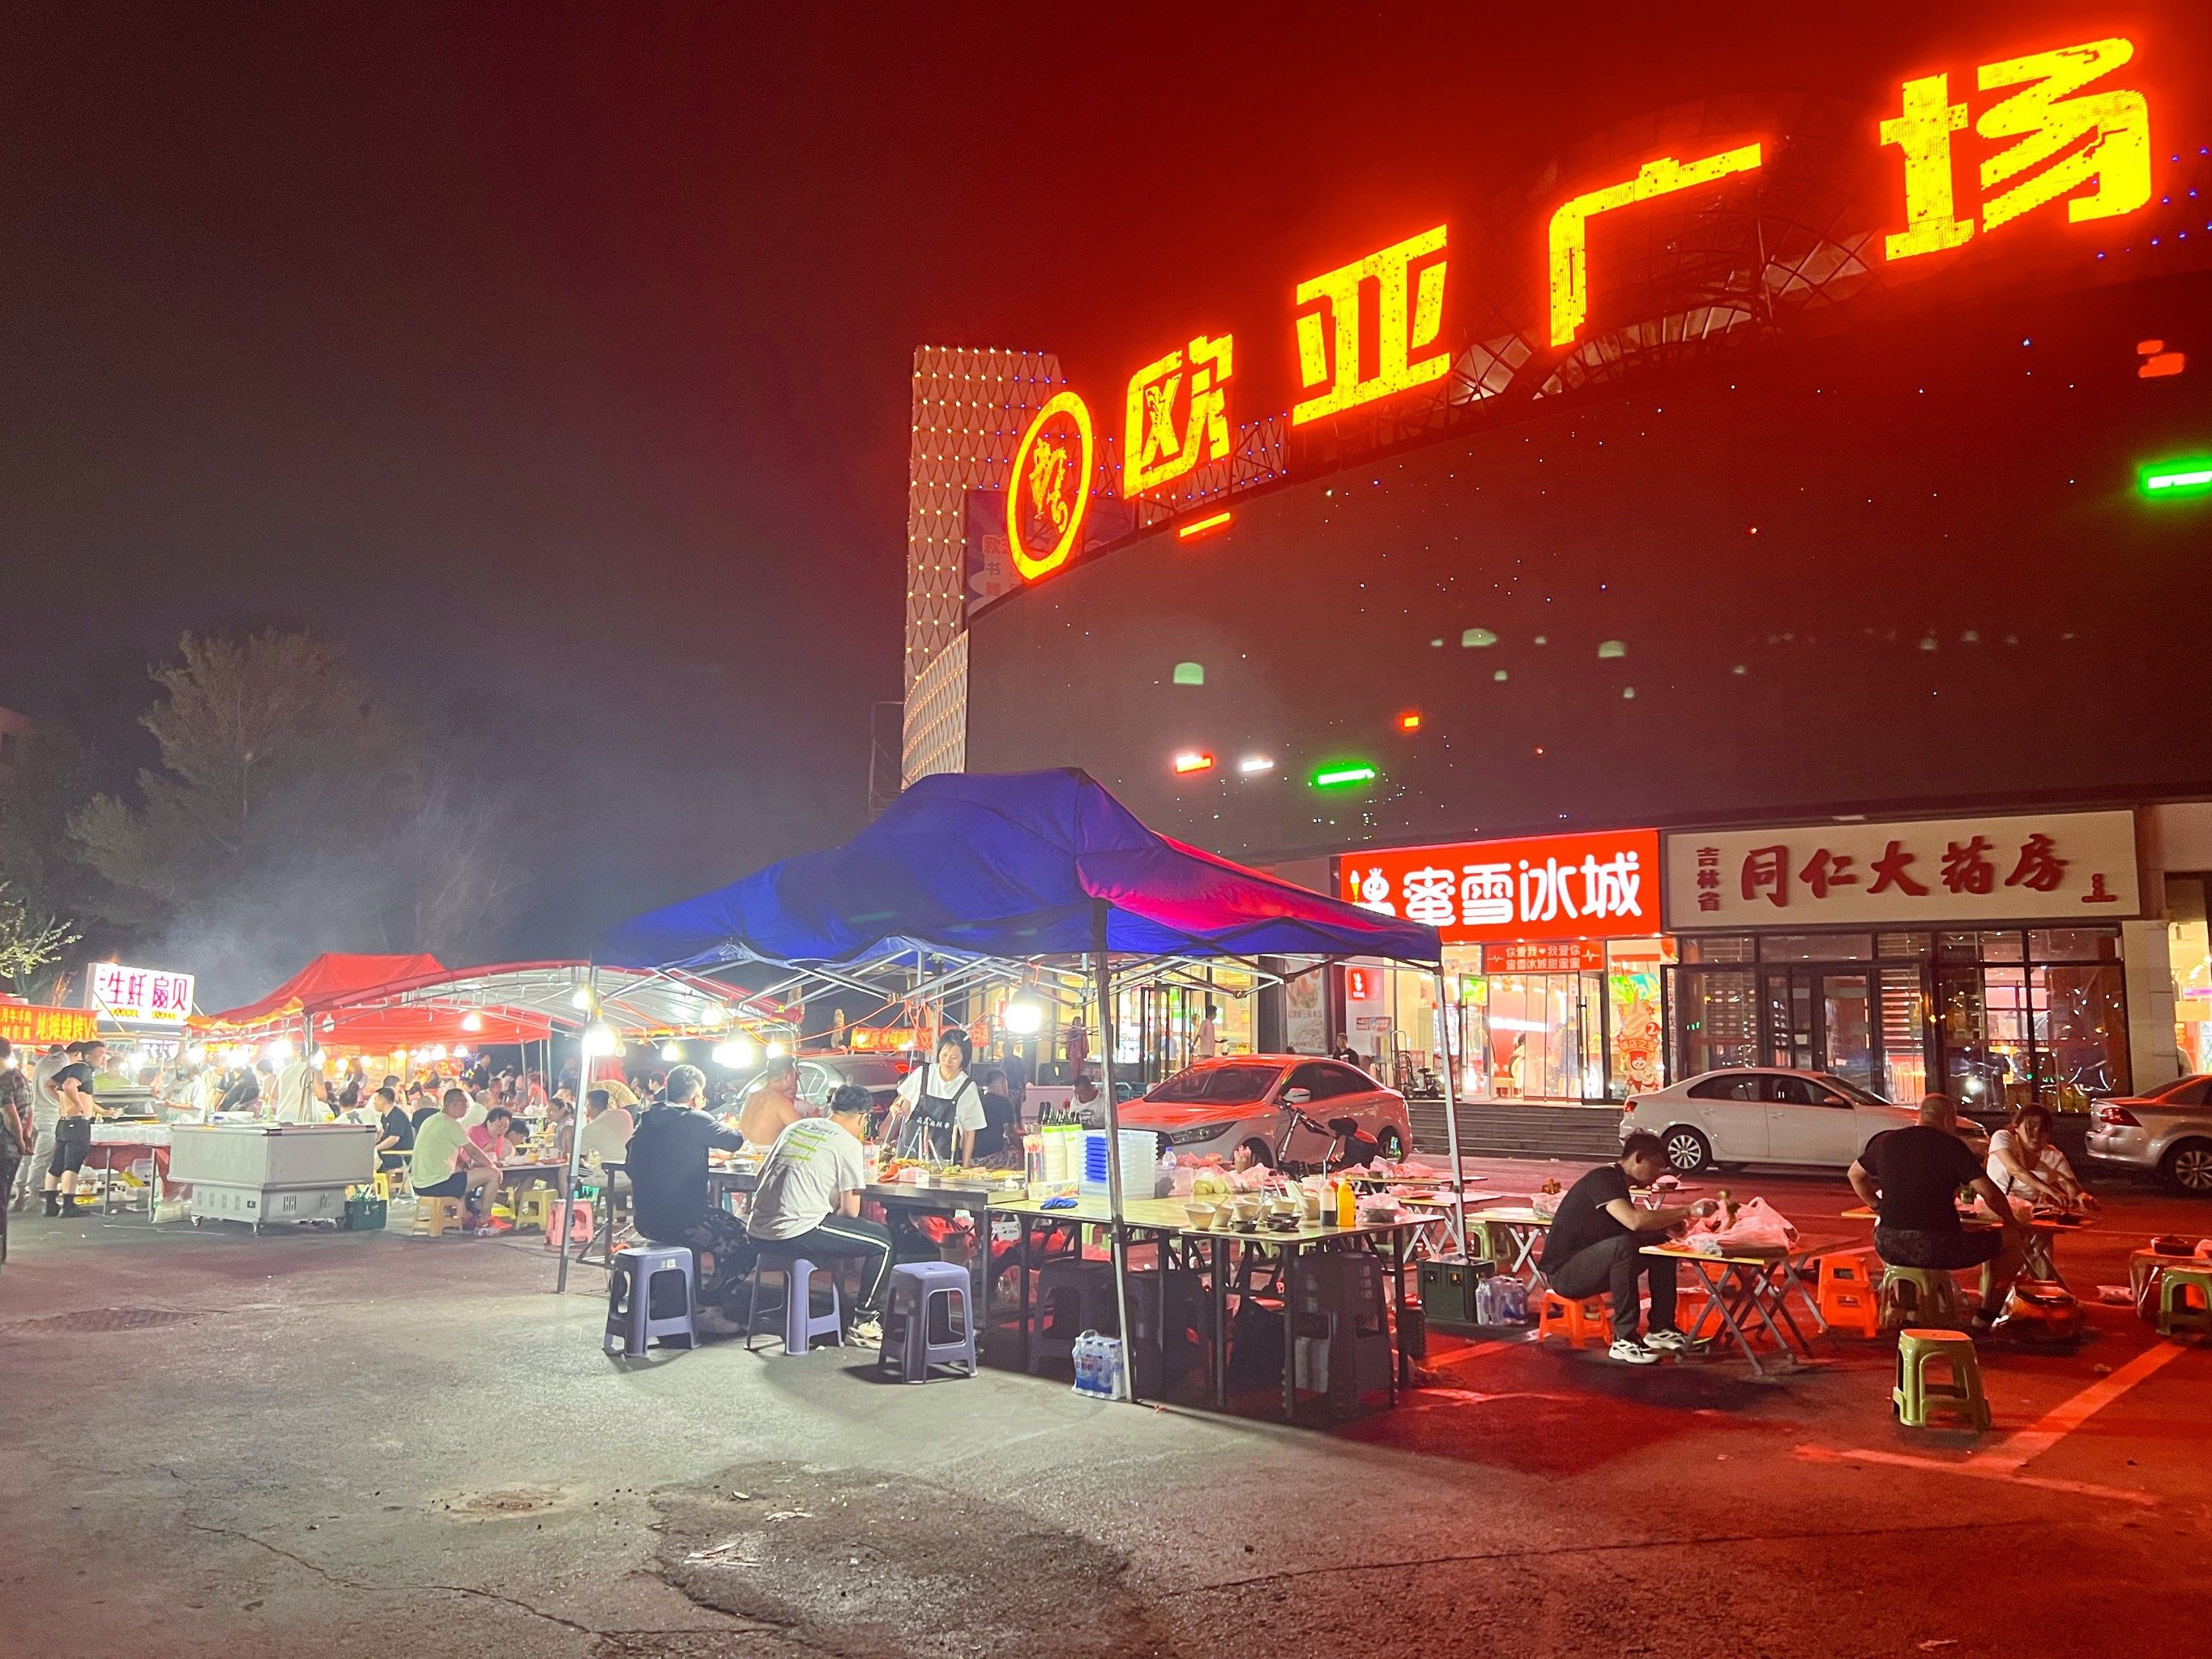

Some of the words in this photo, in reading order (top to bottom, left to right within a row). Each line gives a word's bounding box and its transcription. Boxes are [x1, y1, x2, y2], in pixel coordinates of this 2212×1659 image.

[1123, 36, 2152, 500] 欧亚广场
[1402, 851, 1642, 927] 蜜雪冰城
[1696, 847, 1720, 911] 吉林省
[1740, 833, 2070, 908] 同仁大药房
